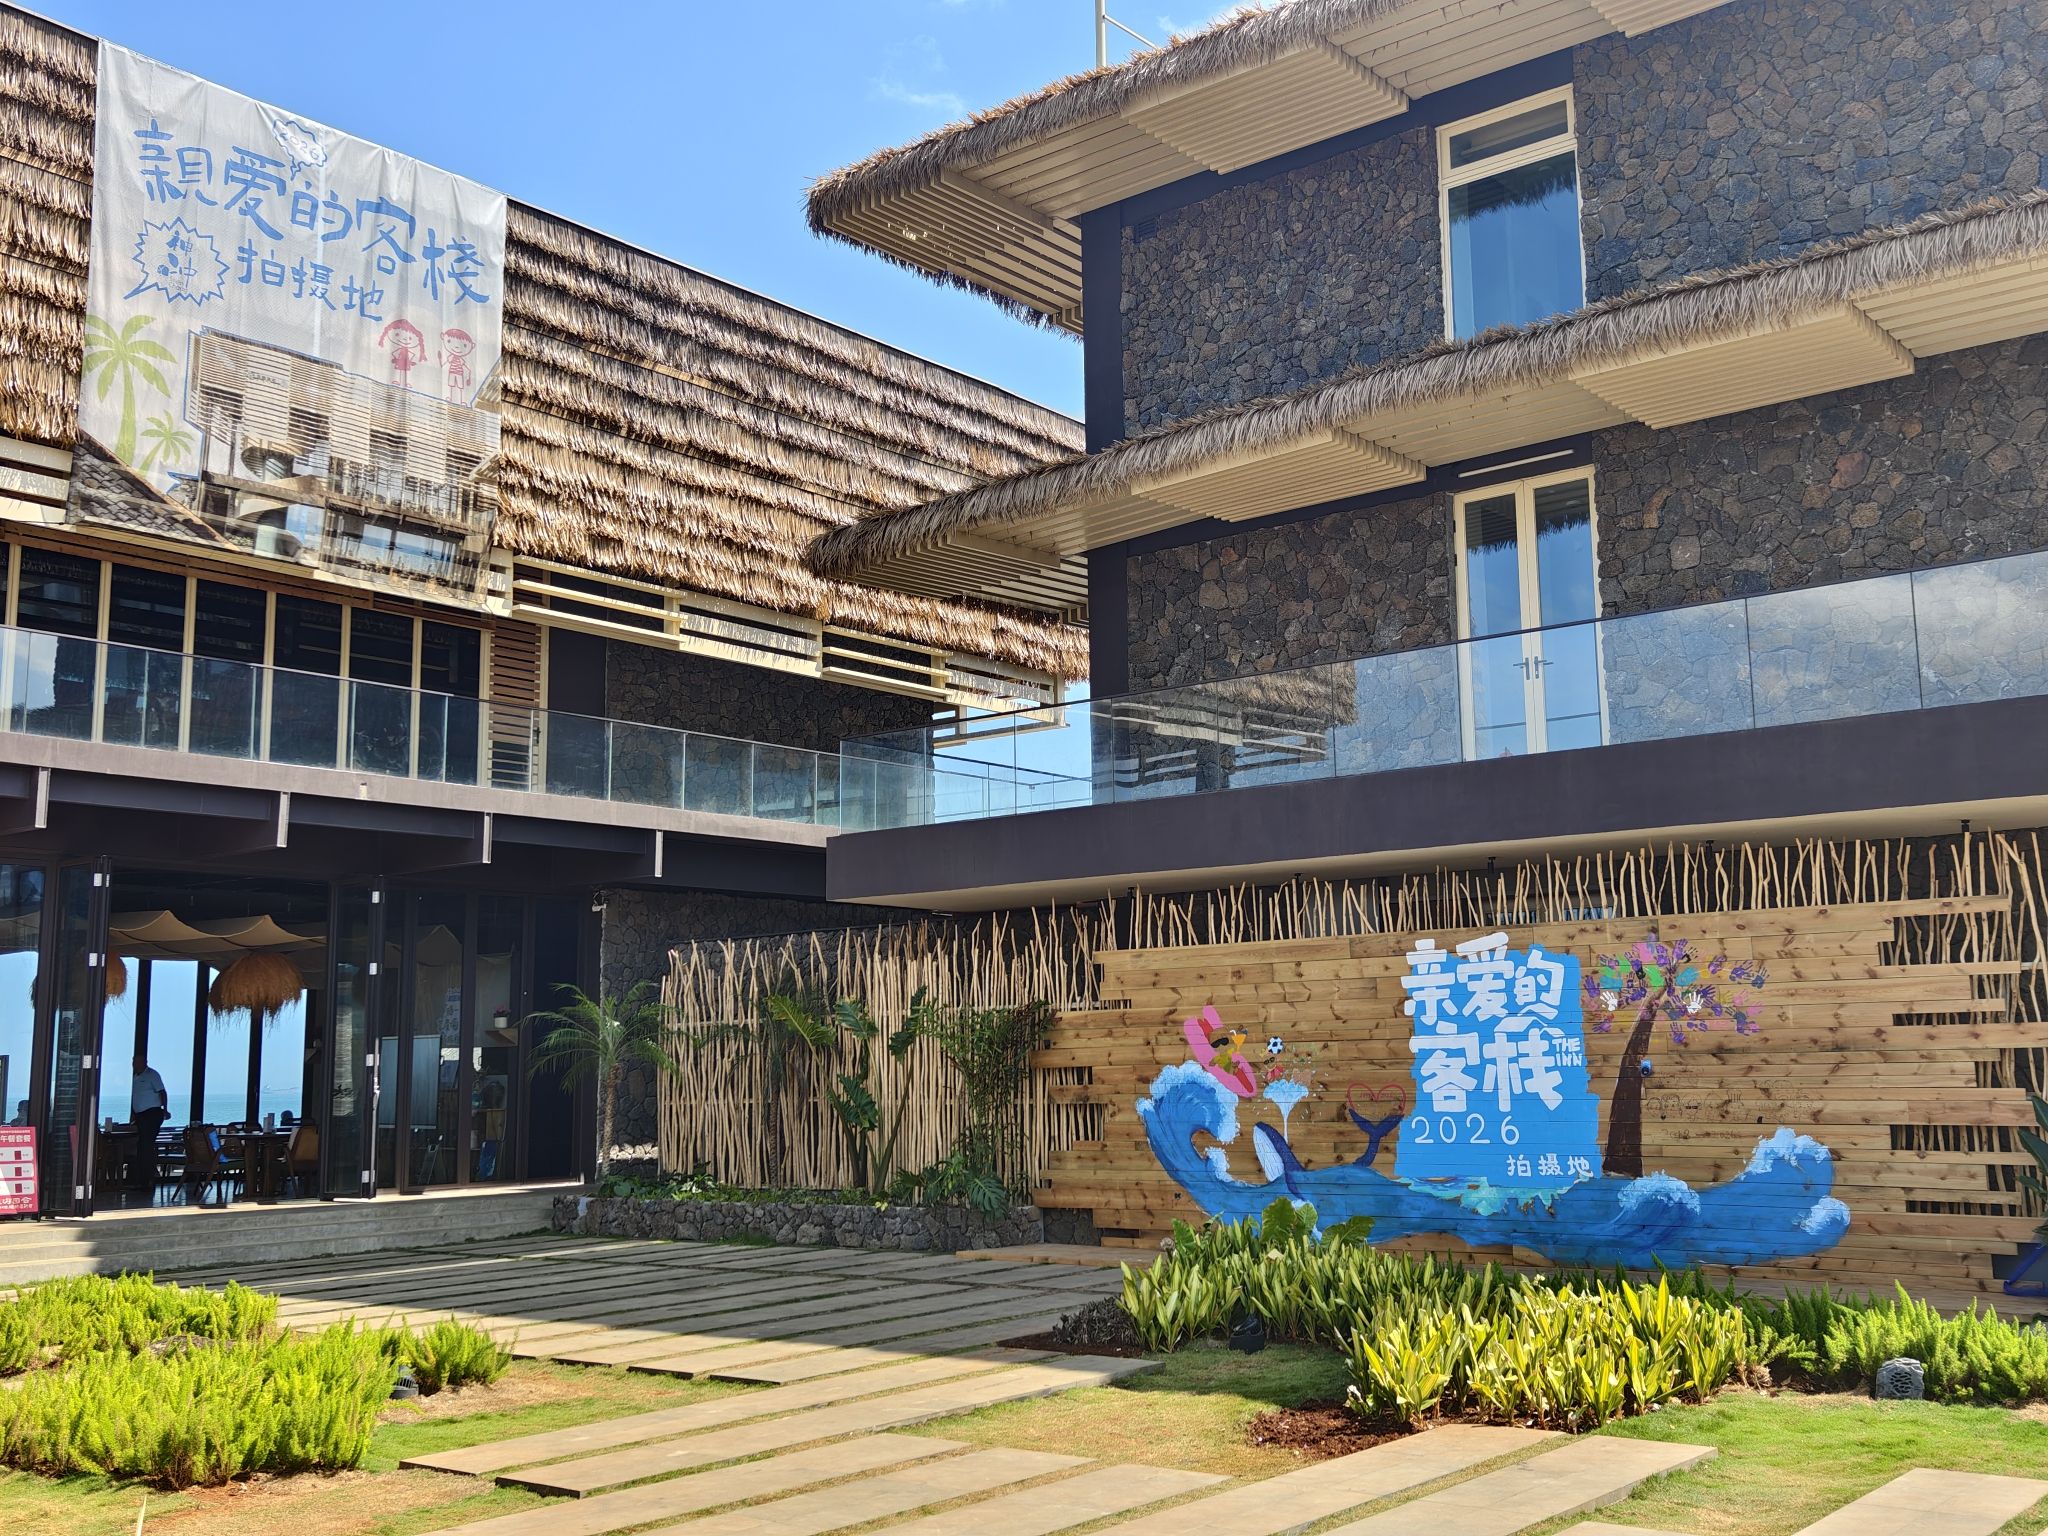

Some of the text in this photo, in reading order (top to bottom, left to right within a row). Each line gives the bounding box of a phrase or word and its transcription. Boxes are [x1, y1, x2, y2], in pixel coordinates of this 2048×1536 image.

[236, 238, 384, 322] 拍摄地
[1401, 932, 1564, 1025] 亲爱的
[1552, 1037, 1581, 1052] THE
[1555, 1053, 1583, 1067] INN
[1409, 1017, 1564, 1112] 客栈
[1410, 1113, 1520, 1145] 2026
[1506, 1153, 1594, 1177] 拍摄地
